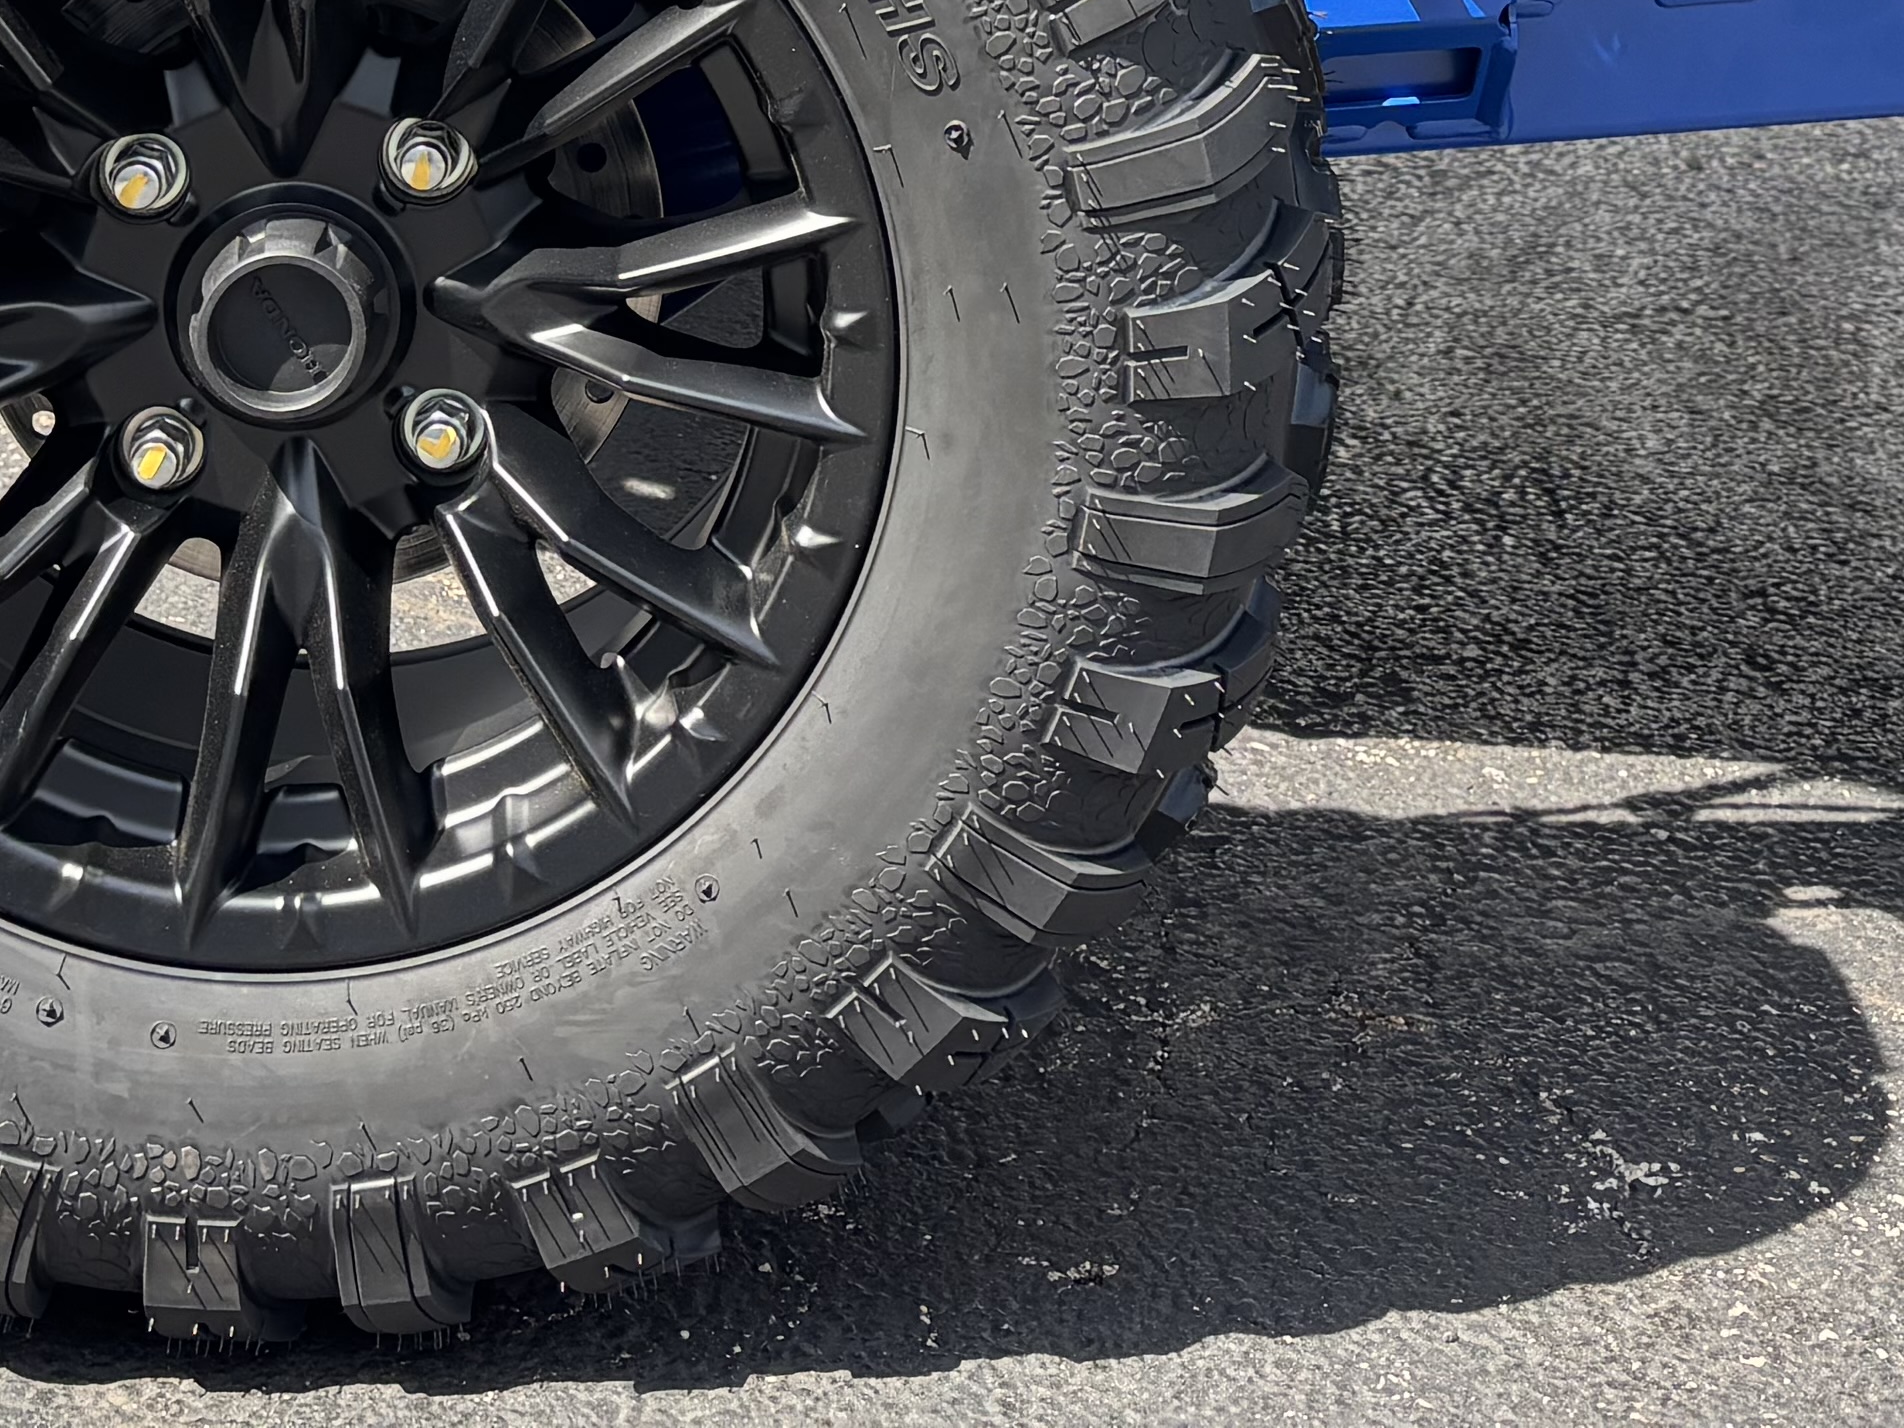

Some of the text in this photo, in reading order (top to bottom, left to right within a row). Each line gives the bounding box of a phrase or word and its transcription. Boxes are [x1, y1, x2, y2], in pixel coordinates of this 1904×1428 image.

[249, 274, 327, 374] HONDA
[650, 875, 676, 902] NOT
[675, 904, 695, 922] DO
[557, 914, 615, 955] HIGHWAY
[639, 917, 709, 972] WARNING
[646, 920, 672, 943] NOT
[197, 890, 684, 1036] SEE VEHICLE LABEL OR OWNER'S MANUAL FOR OPERATING PRESSURE
[494, 945, 550, 979] SERVICE
[586, 938, 641, 976] INFLATE
[529, 970, 583, 1002] BEYOND
[495, 994, 523, 1015] 250
[226, 1039, 274, 1055] BEADS
[282, 1035, 342, 1054] SEATING
[350, 1028, 390, 1048] WHEN
